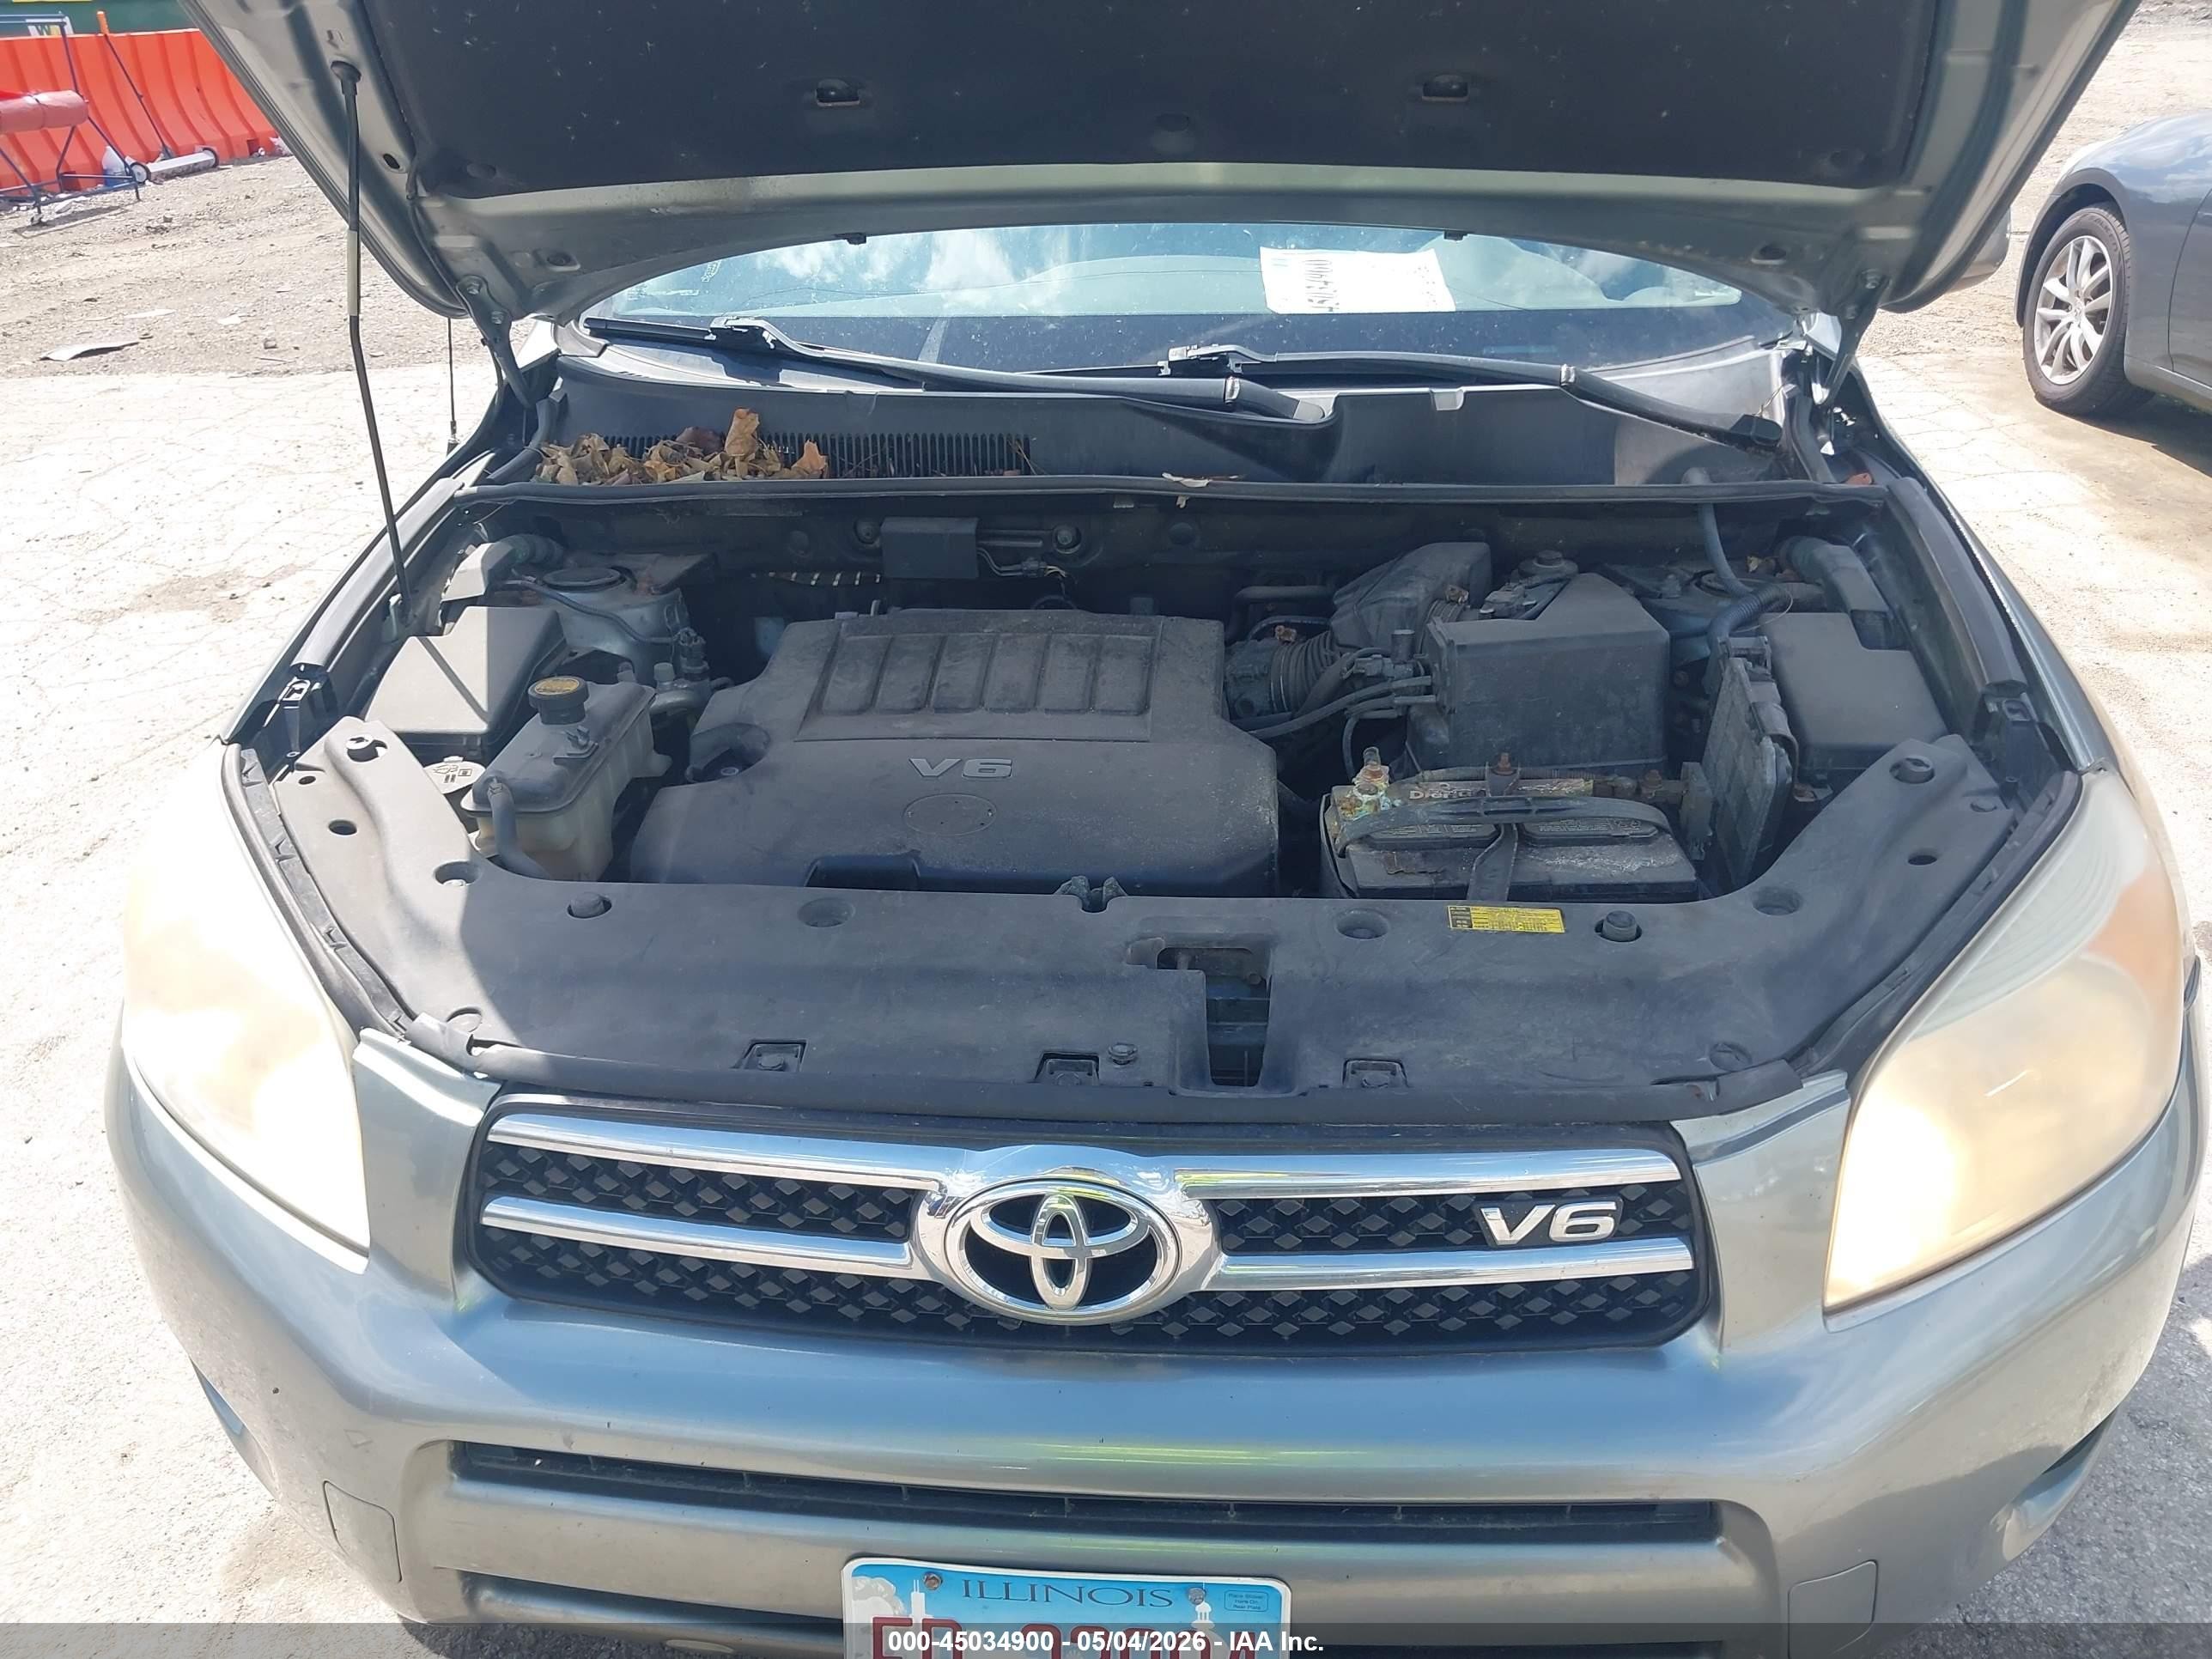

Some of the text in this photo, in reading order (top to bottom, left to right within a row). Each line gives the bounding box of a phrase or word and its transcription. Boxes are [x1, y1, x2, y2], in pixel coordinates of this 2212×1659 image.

[908, 758, 1012, 779] V6
[1480, 1201, 1617, 1246] V6
[962, 1579, 1173, 1607] ILLINOIS
